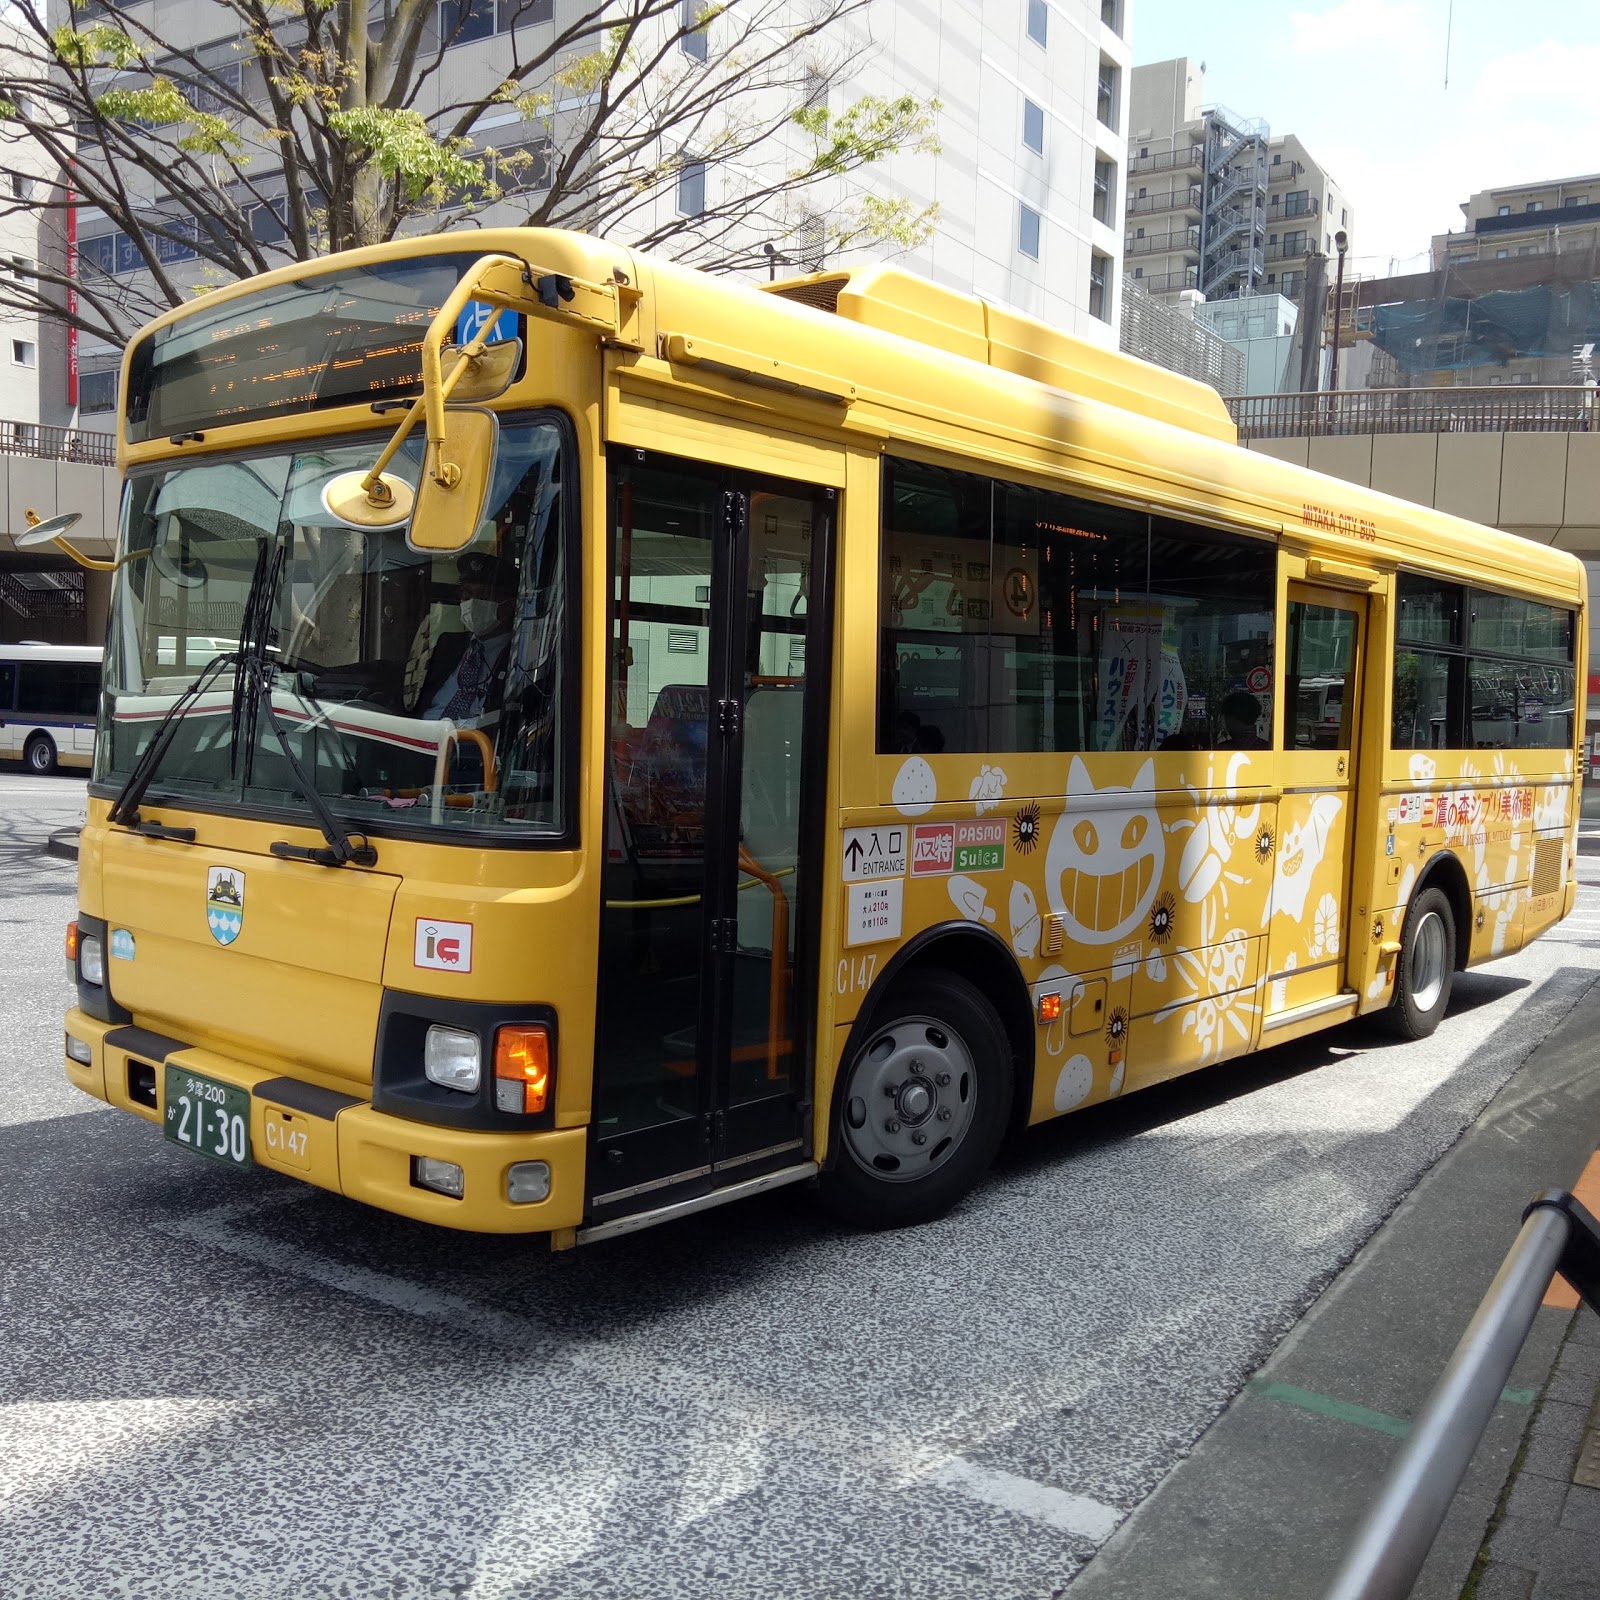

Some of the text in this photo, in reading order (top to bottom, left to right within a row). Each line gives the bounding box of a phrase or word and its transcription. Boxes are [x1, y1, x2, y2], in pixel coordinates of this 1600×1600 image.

[1302, 503, 1376, 542] MITAKA CITY BUS
[1421, 788, 1533, 828] 三鷹の森ジブリ美術館
[868, 832, 902, 856] 入口
[914, 833, 953, 864] バス特
[958, 825, 1001, 843] PASMO
[862, 859, 905, 875] ENTRANCE
[959, 849, 999, 867] Suica
[837, 953, 877, 994] C147
[167, 1096, 246, 1162] か 21-30
[266, 1122, 308, 1157] C147
